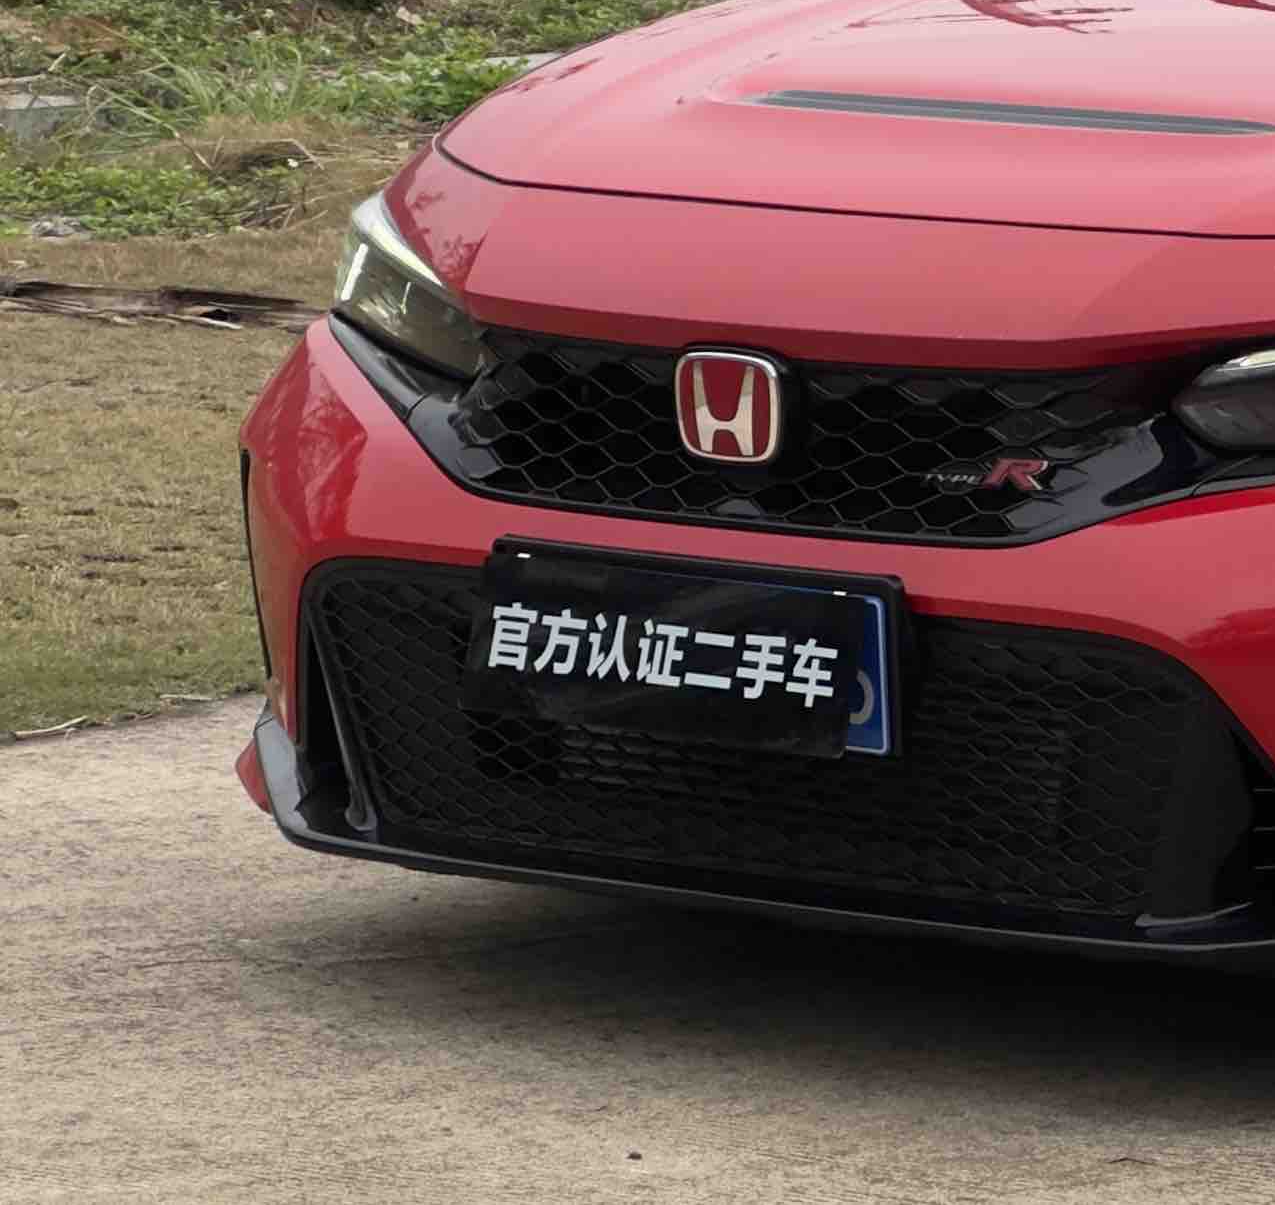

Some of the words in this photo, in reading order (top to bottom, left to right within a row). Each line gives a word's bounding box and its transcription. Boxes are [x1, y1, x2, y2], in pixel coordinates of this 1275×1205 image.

[692, 360, 755, 456] H
[981, 457, 1049, 491] R
[487, 602, 839, 708] 官方认证二手车
